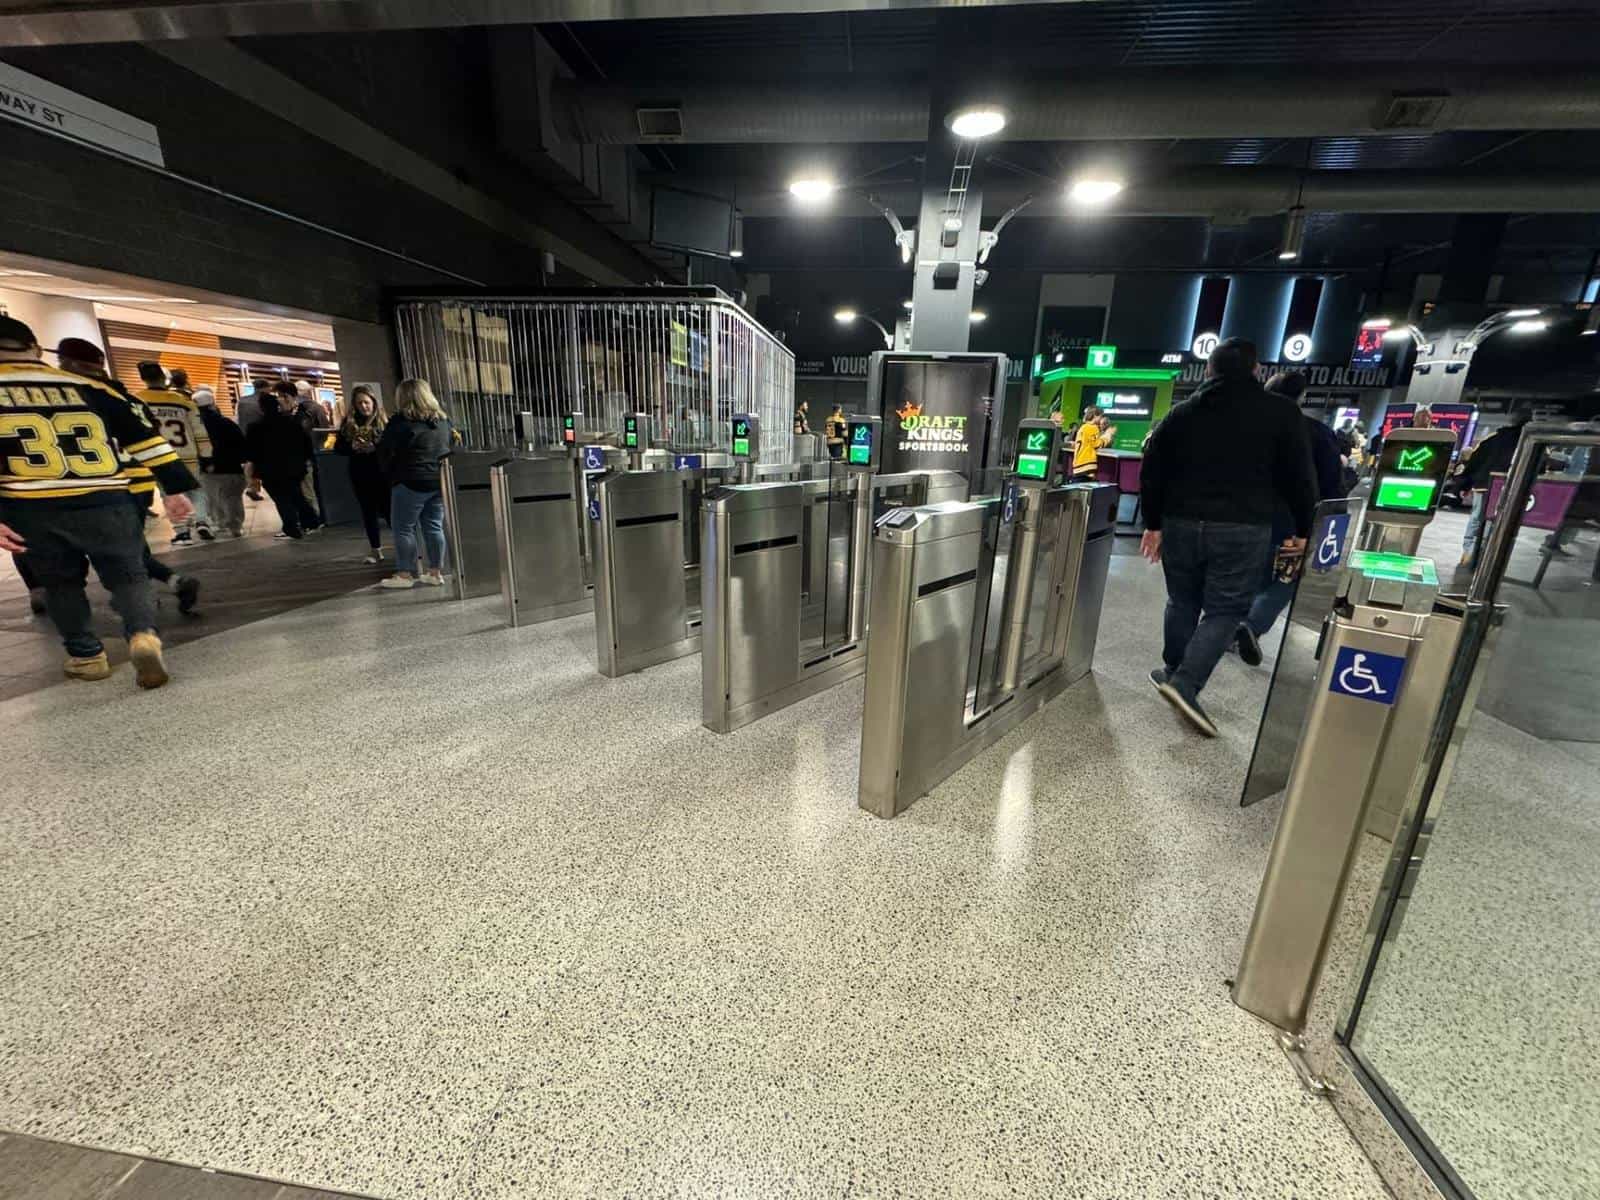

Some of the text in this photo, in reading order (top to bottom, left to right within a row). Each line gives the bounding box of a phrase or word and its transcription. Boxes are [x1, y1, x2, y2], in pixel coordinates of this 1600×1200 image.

[42, 107, 64, 126] ST
[1197, 338, 1217, 355] 10
[1291, 339, 1304, 356] 9
[832, 356, 868, 375] YOUR
[1091, 350, 1114, 367] TD
[1160, 353, 1183, 363] ATM
[1309, 366, 1330, 385] TO
[1330, 366, 1389, 386] ACTION
[900, 415, 967, 431] DRAFT
[907, 428, 964, 441] KINGS
[0, 412, 119, 478] 33
[898, 442, 969, 452] SPORTSBOOK
